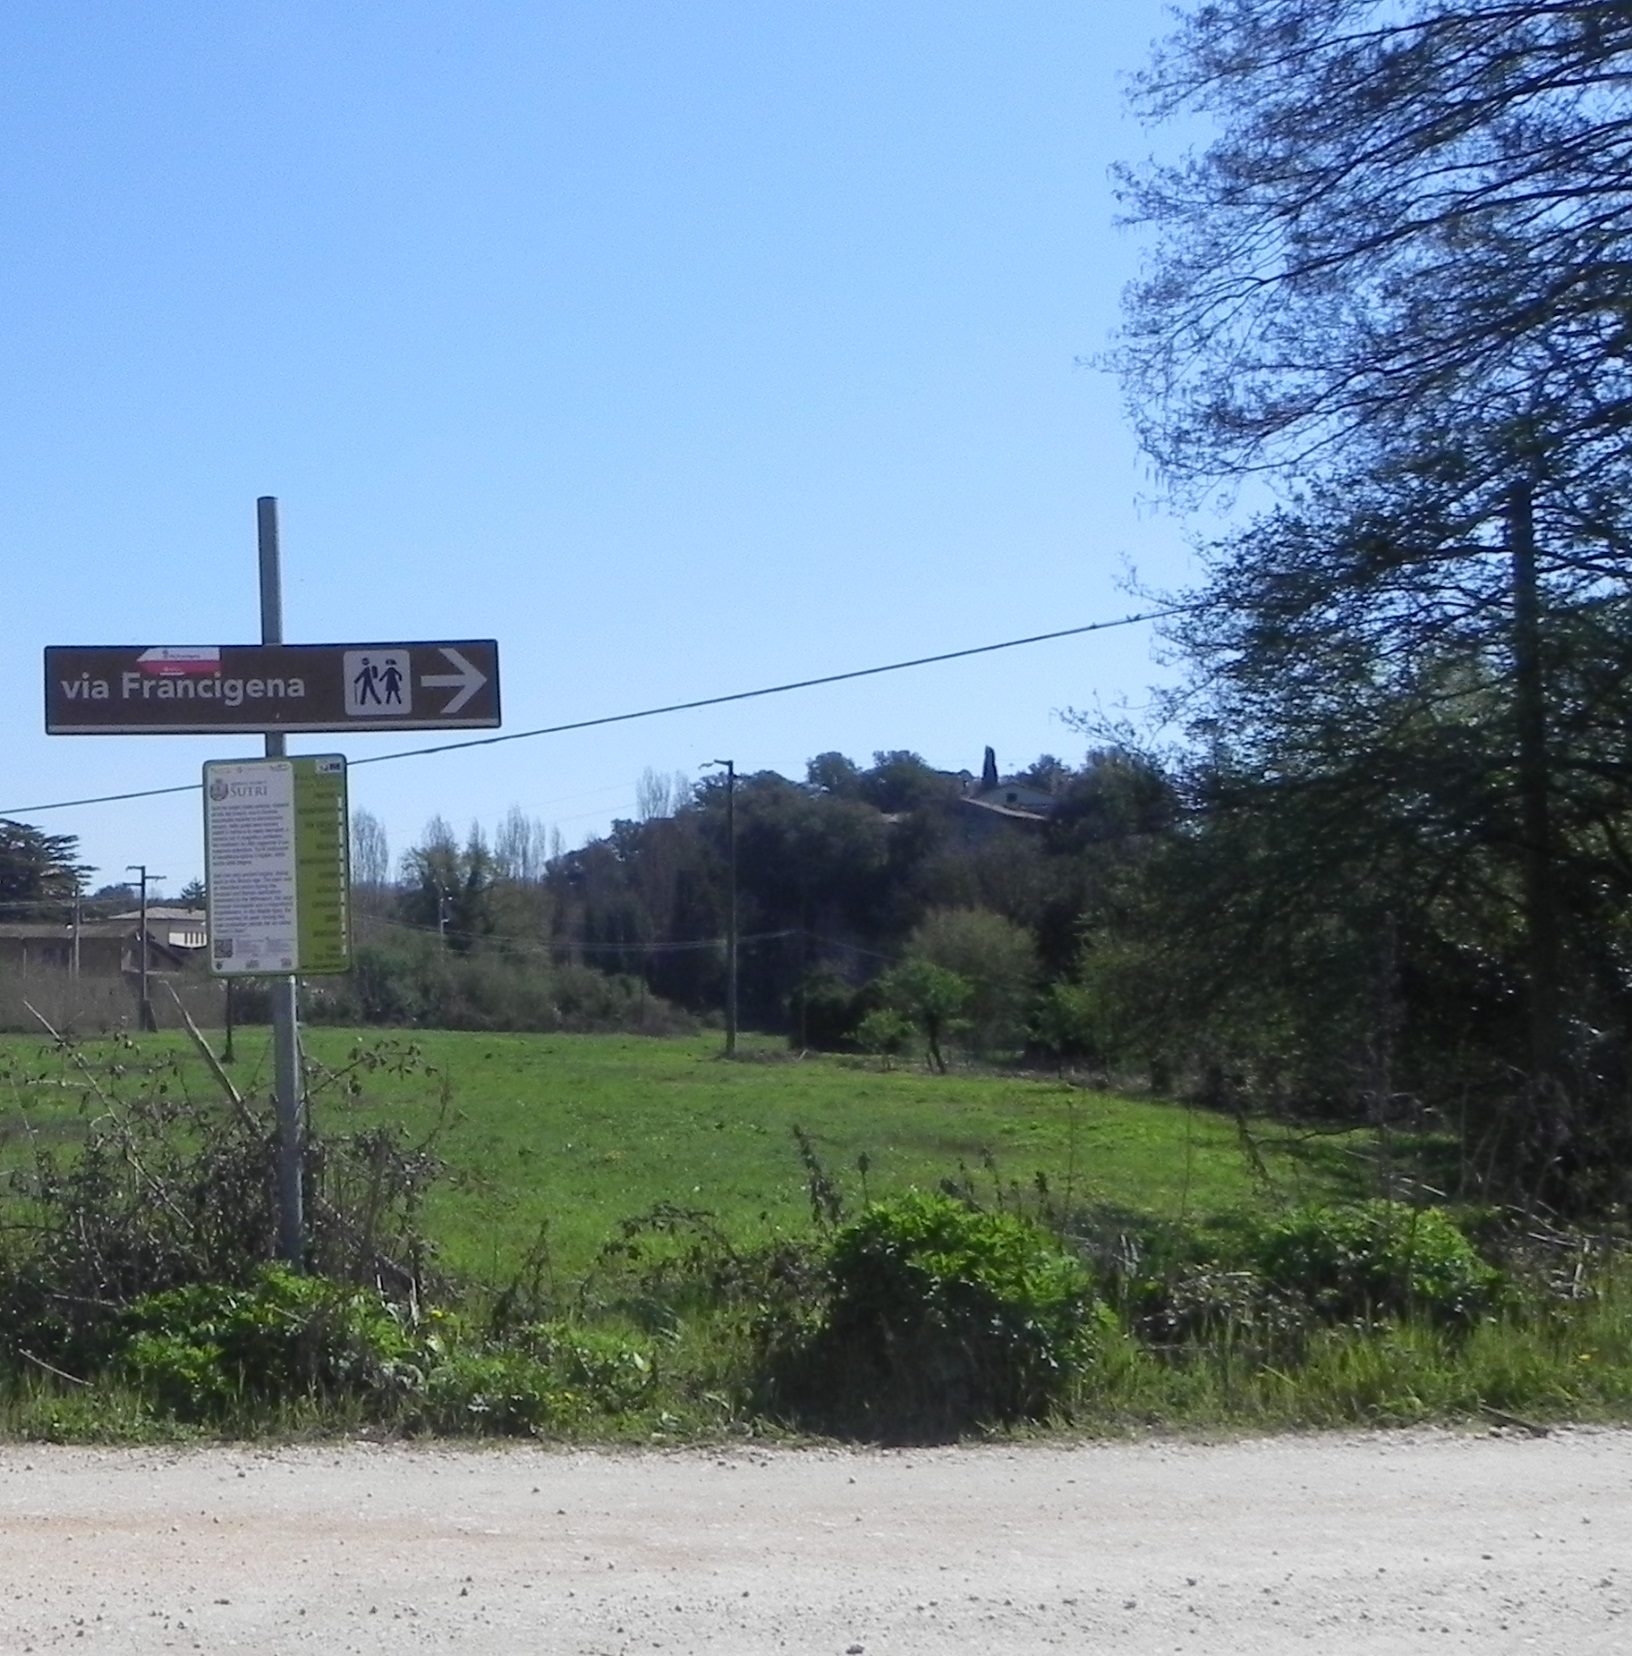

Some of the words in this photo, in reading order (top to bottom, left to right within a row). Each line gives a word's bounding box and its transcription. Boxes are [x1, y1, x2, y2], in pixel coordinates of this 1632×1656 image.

[61, 672, 109, 699] via
[122, 671, 305, 706] Francigena
[229, 785, 268, 797] SUTRI
